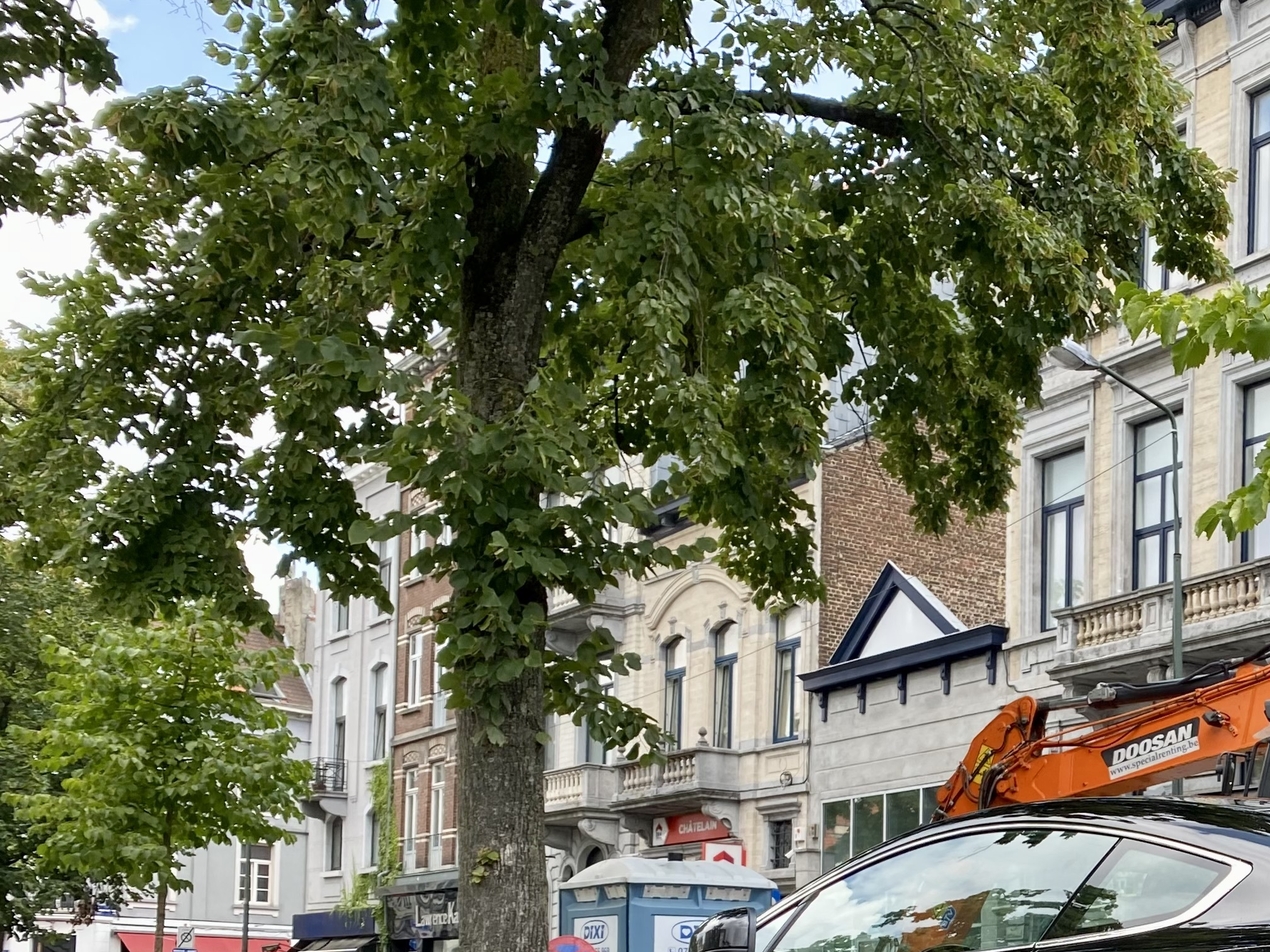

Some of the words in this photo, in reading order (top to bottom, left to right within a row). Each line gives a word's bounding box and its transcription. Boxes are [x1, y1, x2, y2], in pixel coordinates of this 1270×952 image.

[1110, 740, 1199, 776] www.specialrenting.be
[1112, 723, 1193, 765] DOOSAN
[678, 820, 718, 835] CHÂTELAIN
